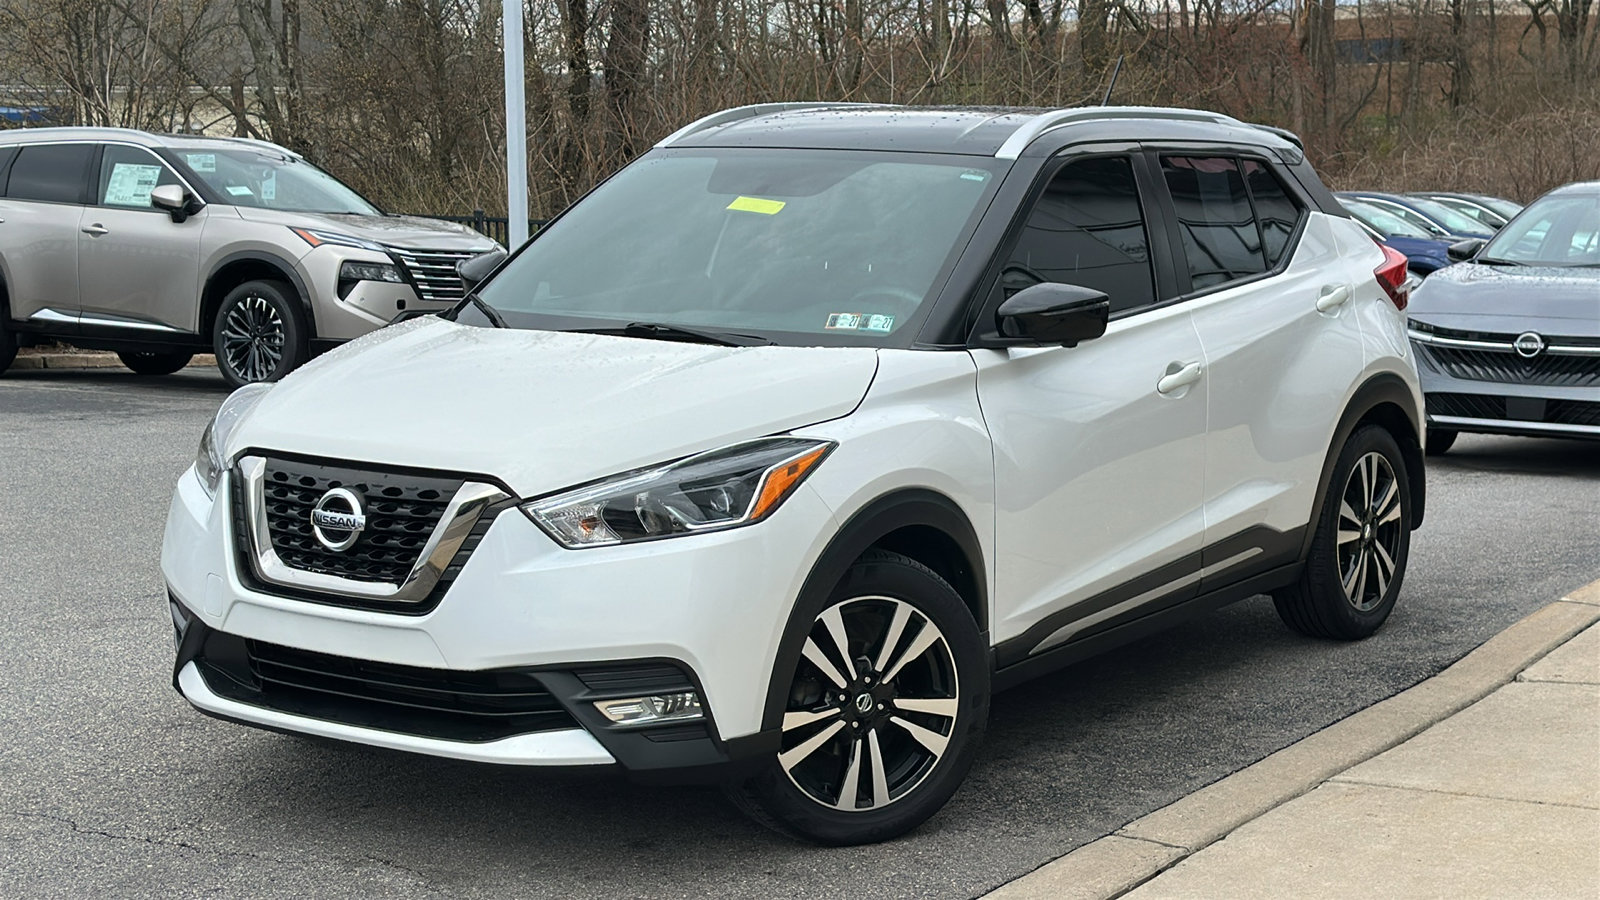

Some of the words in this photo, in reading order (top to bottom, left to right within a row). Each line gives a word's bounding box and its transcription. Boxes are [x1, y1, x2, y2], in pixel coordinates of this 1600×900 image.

[849, 315, 858, 327] 27
[882, 317, 892, 329] 27
[313, 513, 356, 527] NISSAN
